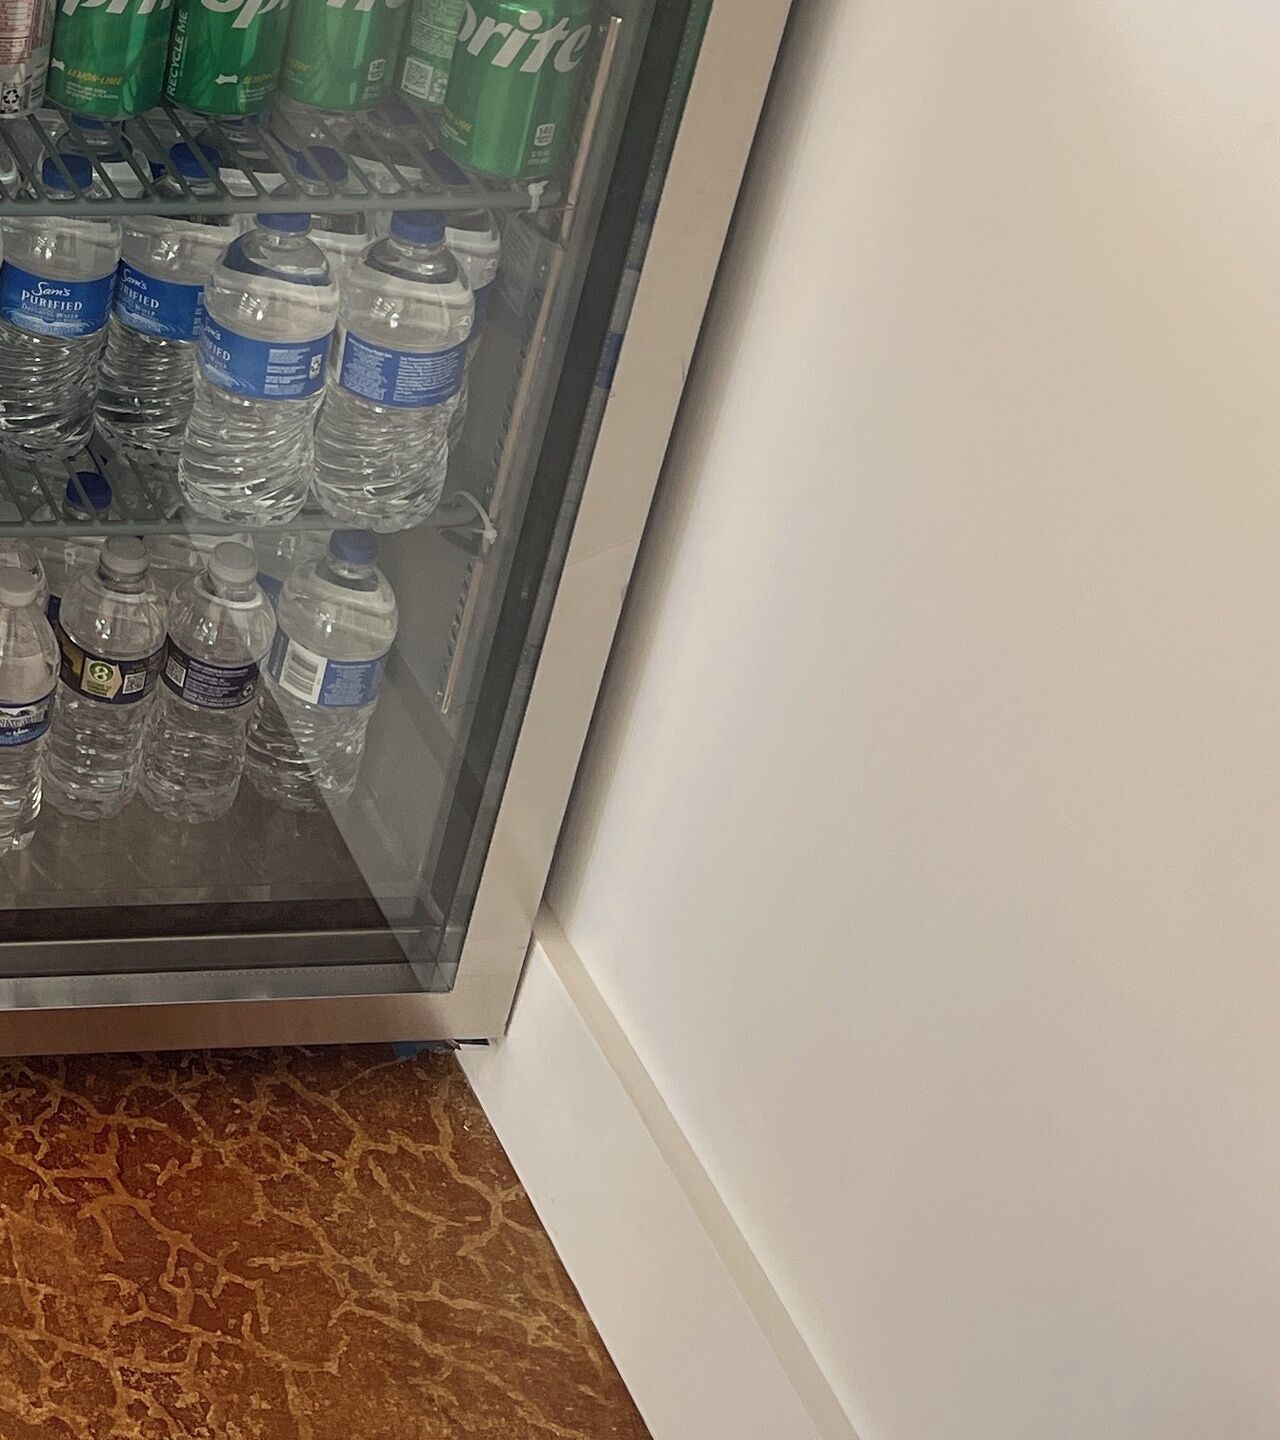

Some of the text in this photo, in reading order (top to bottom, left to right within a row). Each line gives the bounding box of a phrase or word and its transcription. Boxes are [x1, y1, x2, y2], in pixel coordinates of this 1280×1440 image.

[167, 11, 189, 97] RECYCLE ME
[21, 289, 83, 311] PURIFIED
[34, 282, 71, 297] Sam's
